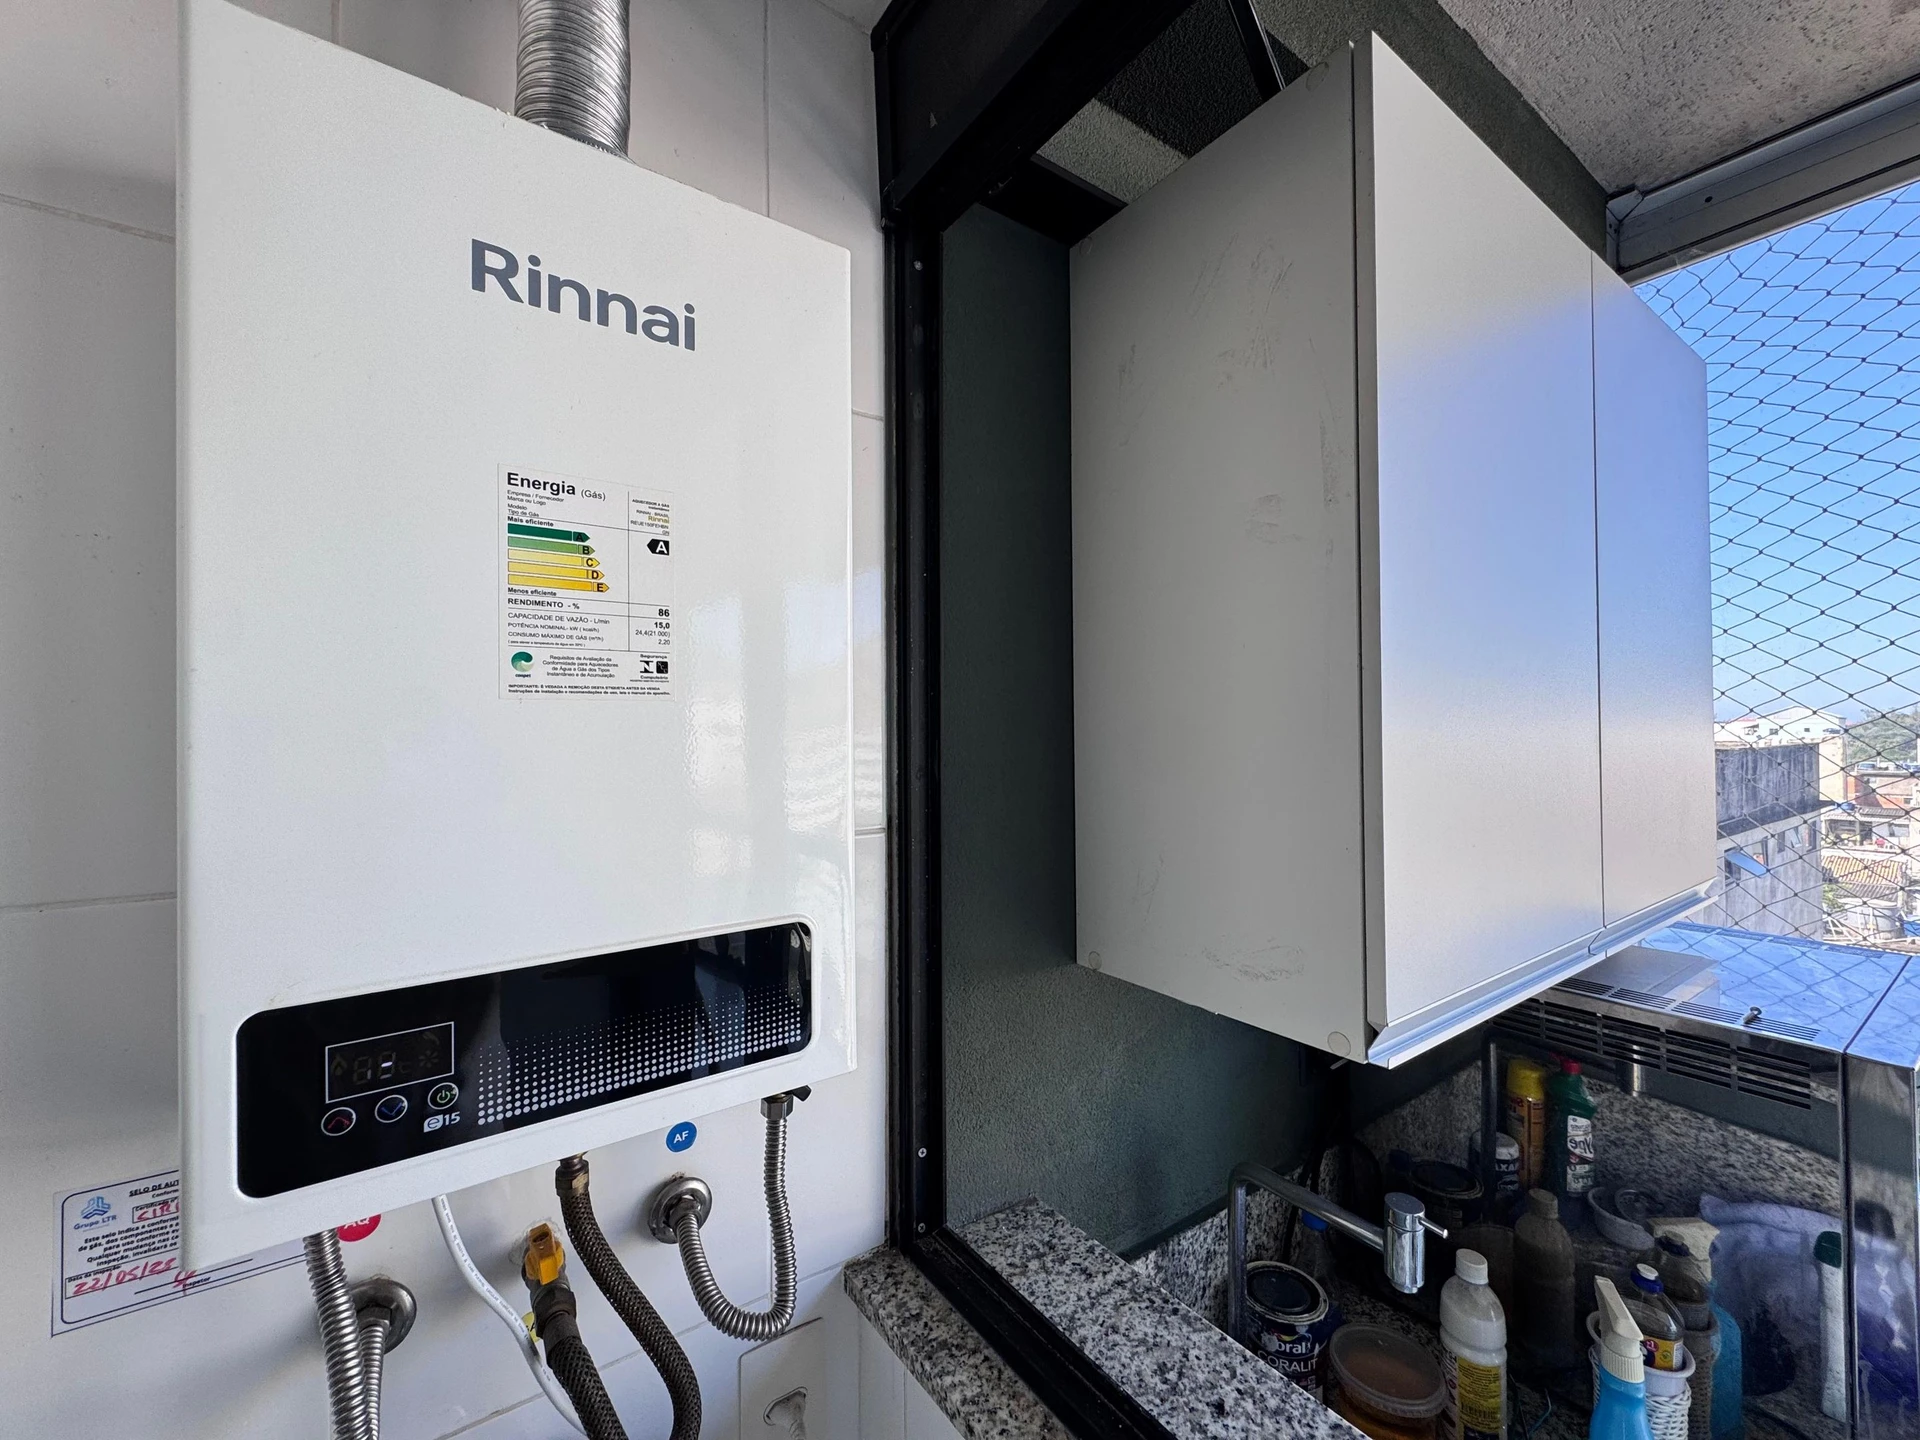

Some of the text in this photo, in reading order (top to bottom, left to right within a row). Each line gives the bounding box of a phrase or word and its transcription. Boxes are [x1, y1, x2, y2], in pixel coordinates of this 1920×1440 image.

[471, 238, 696, 351] Rinnai
[507, 472, 606, 501] Energia (Gás)
[507, 490, 531, 498] Empresa
[535, 494, 564, 502] Fornecedor
[508, 508, 519, 516] Tipo
[507, 515, 554, 527] Mais eficiente
[648, 516, 670, 524] Rinnai
[576, 532, 584, 542] A
[582, 546, 590, 555] B
[656, 541, 668, 554] A
[586, 558, 594, 568] C
[592, 570, 599, 580] D
[597, 583, 604, 592] E
[507, 598, 564, 608] RENDIMENTO
[572, 602, 580, 610] %
[508, 612, 553, 621] CAPACIDADE
[658, 608, 670, 617] 86
[654, 622, 670, 630] 15,0
[673, 1130, 689, 1144] AF
[129, 1187, 150, 1197] SELO
[152, 1183, 162, 1192] DE
[74, 1220, 99, 1230] Grupo
[84, 1236, 100, 1244] Este
[101, 1232, 116, 1240] selo
[118, 1226, 139, 1235] indica
[105, 1237, 118, 1245] dos
[120, 1225, 168, 1240] componentes
[103, 1244, 120, 1252] para
[136, 1231, 170, 1243] conforme
[87, 1250, 121, 1263] Qualquer
[123, 1241, 156, 1253] mudança
[133, 1244, 168, 1257] invalidará
[1258, 1350, 1318, 1372] CORALIT
